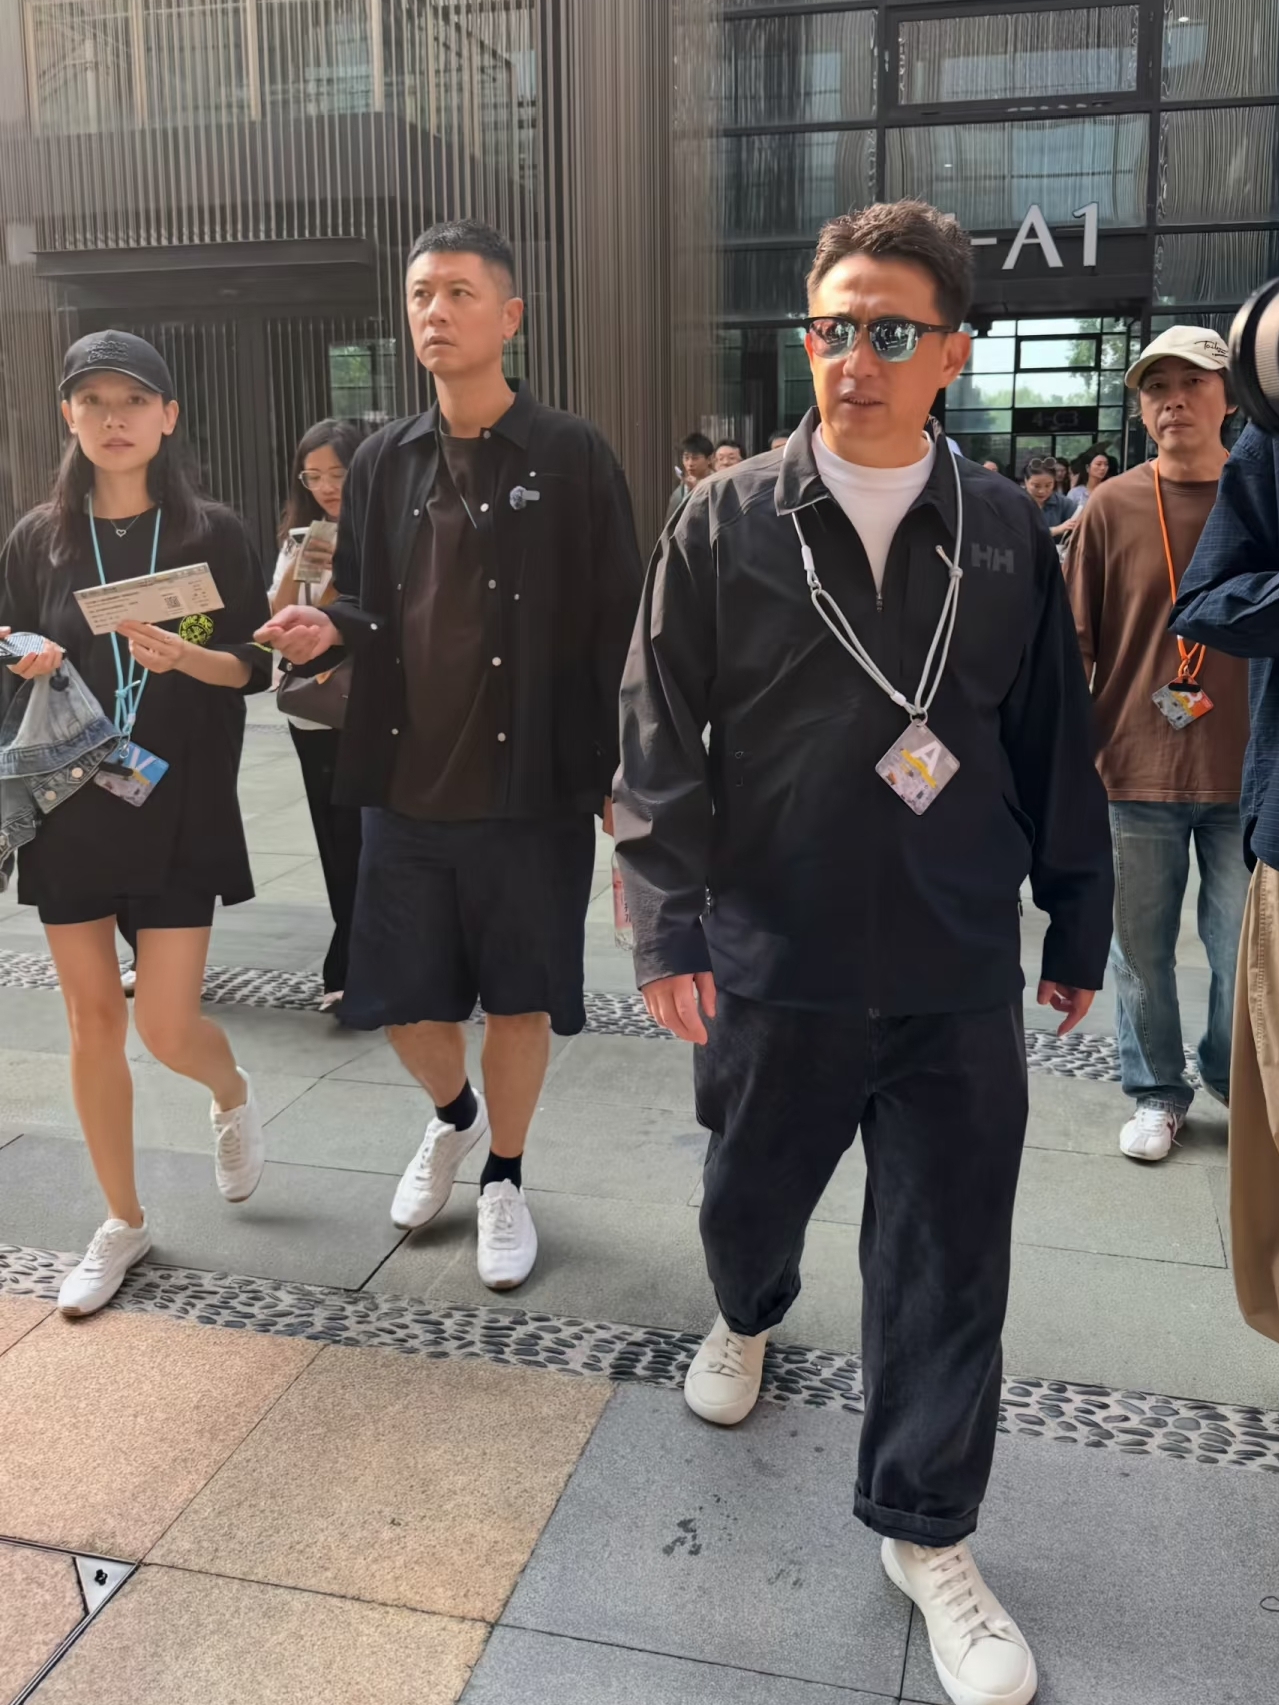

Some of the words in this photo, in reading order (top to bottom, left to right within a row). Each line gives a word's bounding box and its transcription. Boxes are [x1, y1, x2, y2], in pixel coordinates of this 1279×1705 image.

[948, 202, 1098, 270] -A1
[971, 543, 1014, 574] HH
[910, 740, 942, 777] A
